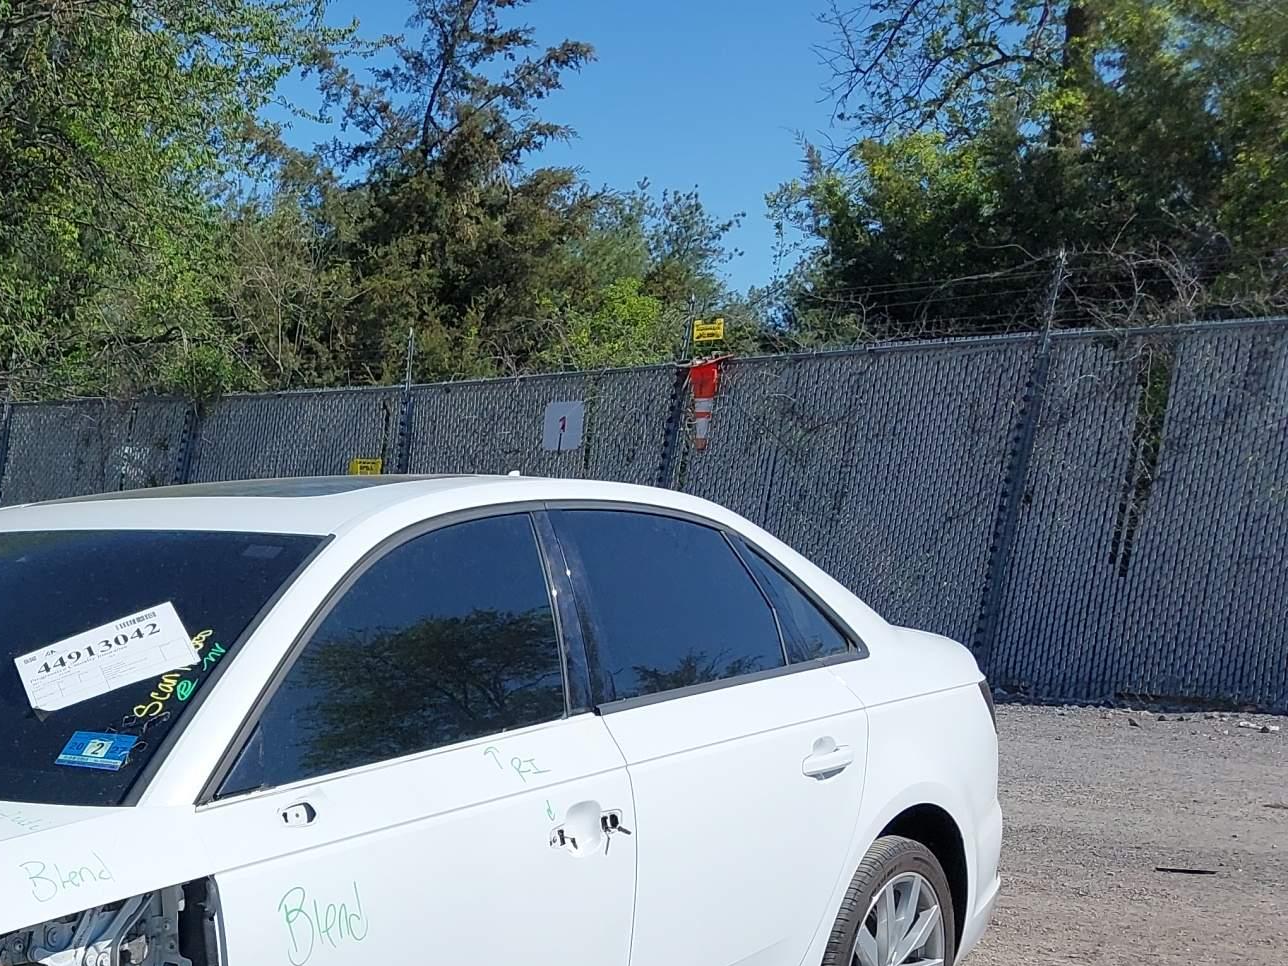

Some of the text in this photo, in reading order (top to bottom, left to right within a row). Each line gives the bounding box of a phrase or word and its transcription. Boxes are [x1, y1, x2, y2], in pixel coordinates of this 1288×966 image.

[37, 622, 161, 674] 44913042
[133, 672, 181, 717] Scan
[19, 850, 115, 902] Blend
[278, 881, 368, 966] Blend
